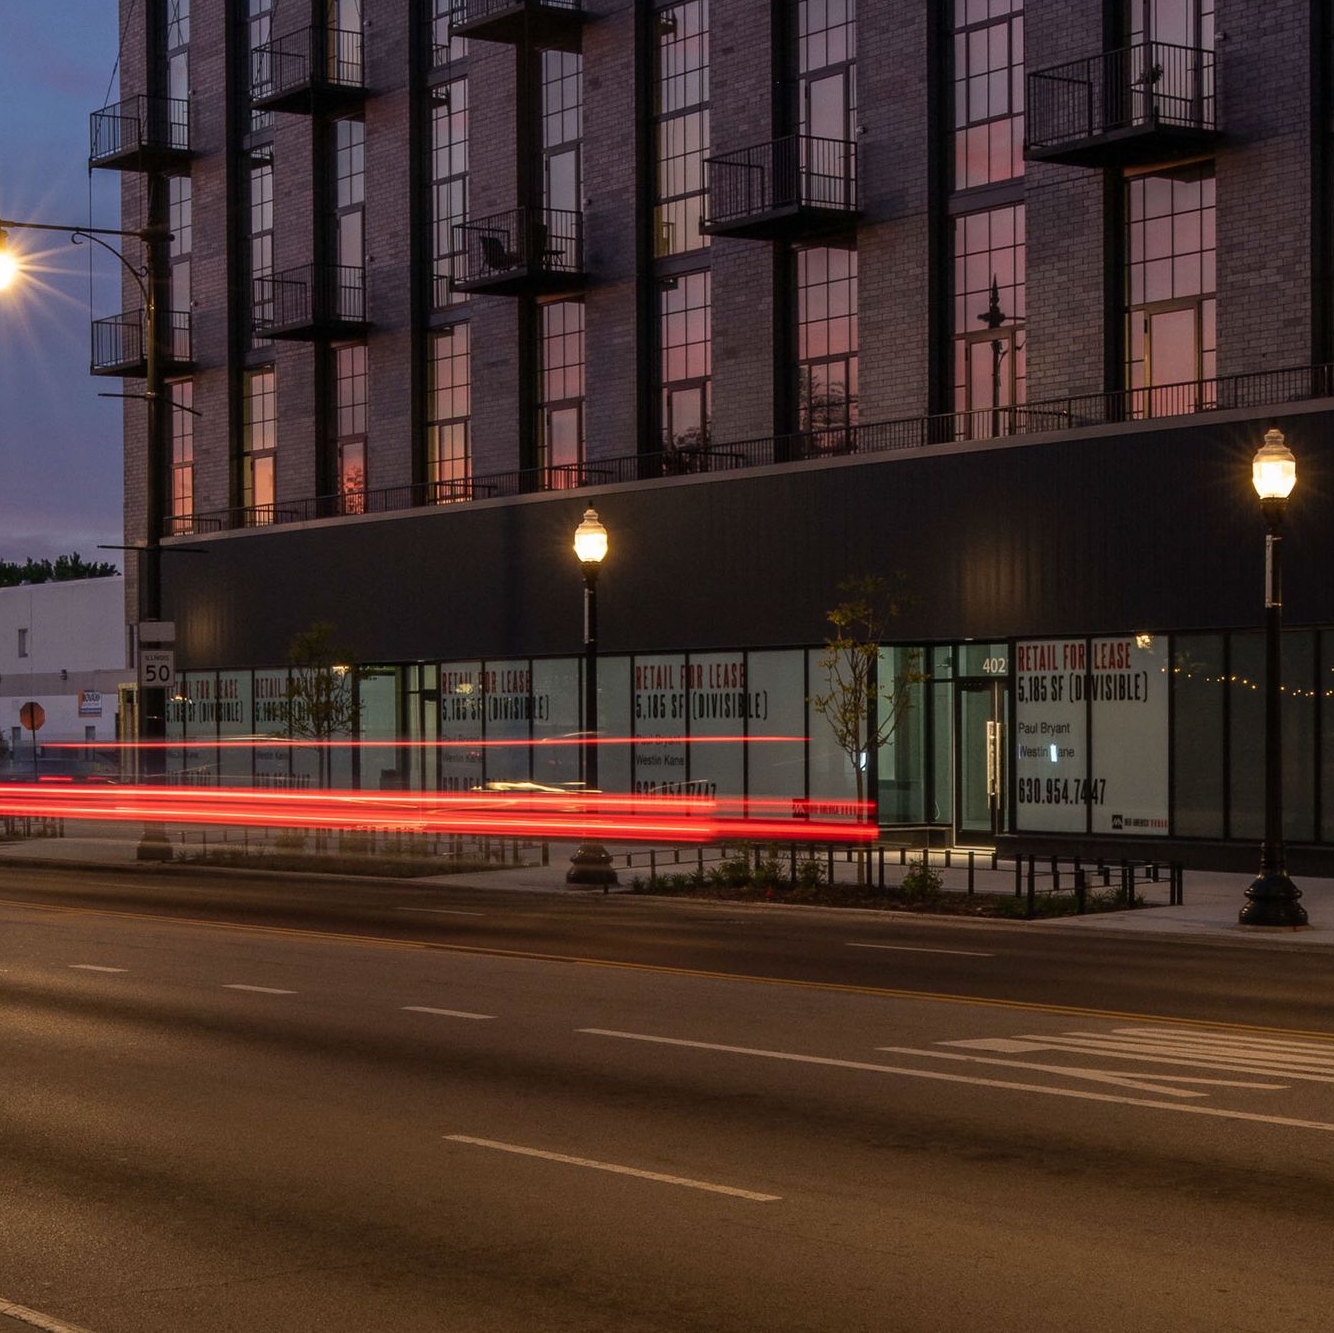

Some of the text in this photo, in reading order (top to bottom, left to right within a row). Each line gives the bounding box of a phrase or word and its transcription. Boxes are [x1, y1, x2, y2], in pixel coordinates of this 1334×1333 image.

[1018, 642, 1131, 671] RETAIL FOR LEASE
[146, 665, 170, 682] 50
[442, 672, 472, 694] RETAIL
[502, 670, 531, 693] LEASE
[636, 663, 746, 690] RETAIL FOR LEASE
[1018, 671, 1149, 704] 5,185 SF (DIVISIBLE)
[636, 690, 768, 721] 5,185 SF (DIVISIBLE)
[1019, 722, 1070, 737] Paul Bryant
[636, 754, 684, 766] Westin Kane
[1019, 746, 1075, 758] Westin ane
[1018, 777, 1106, 805] 630.954.7447
